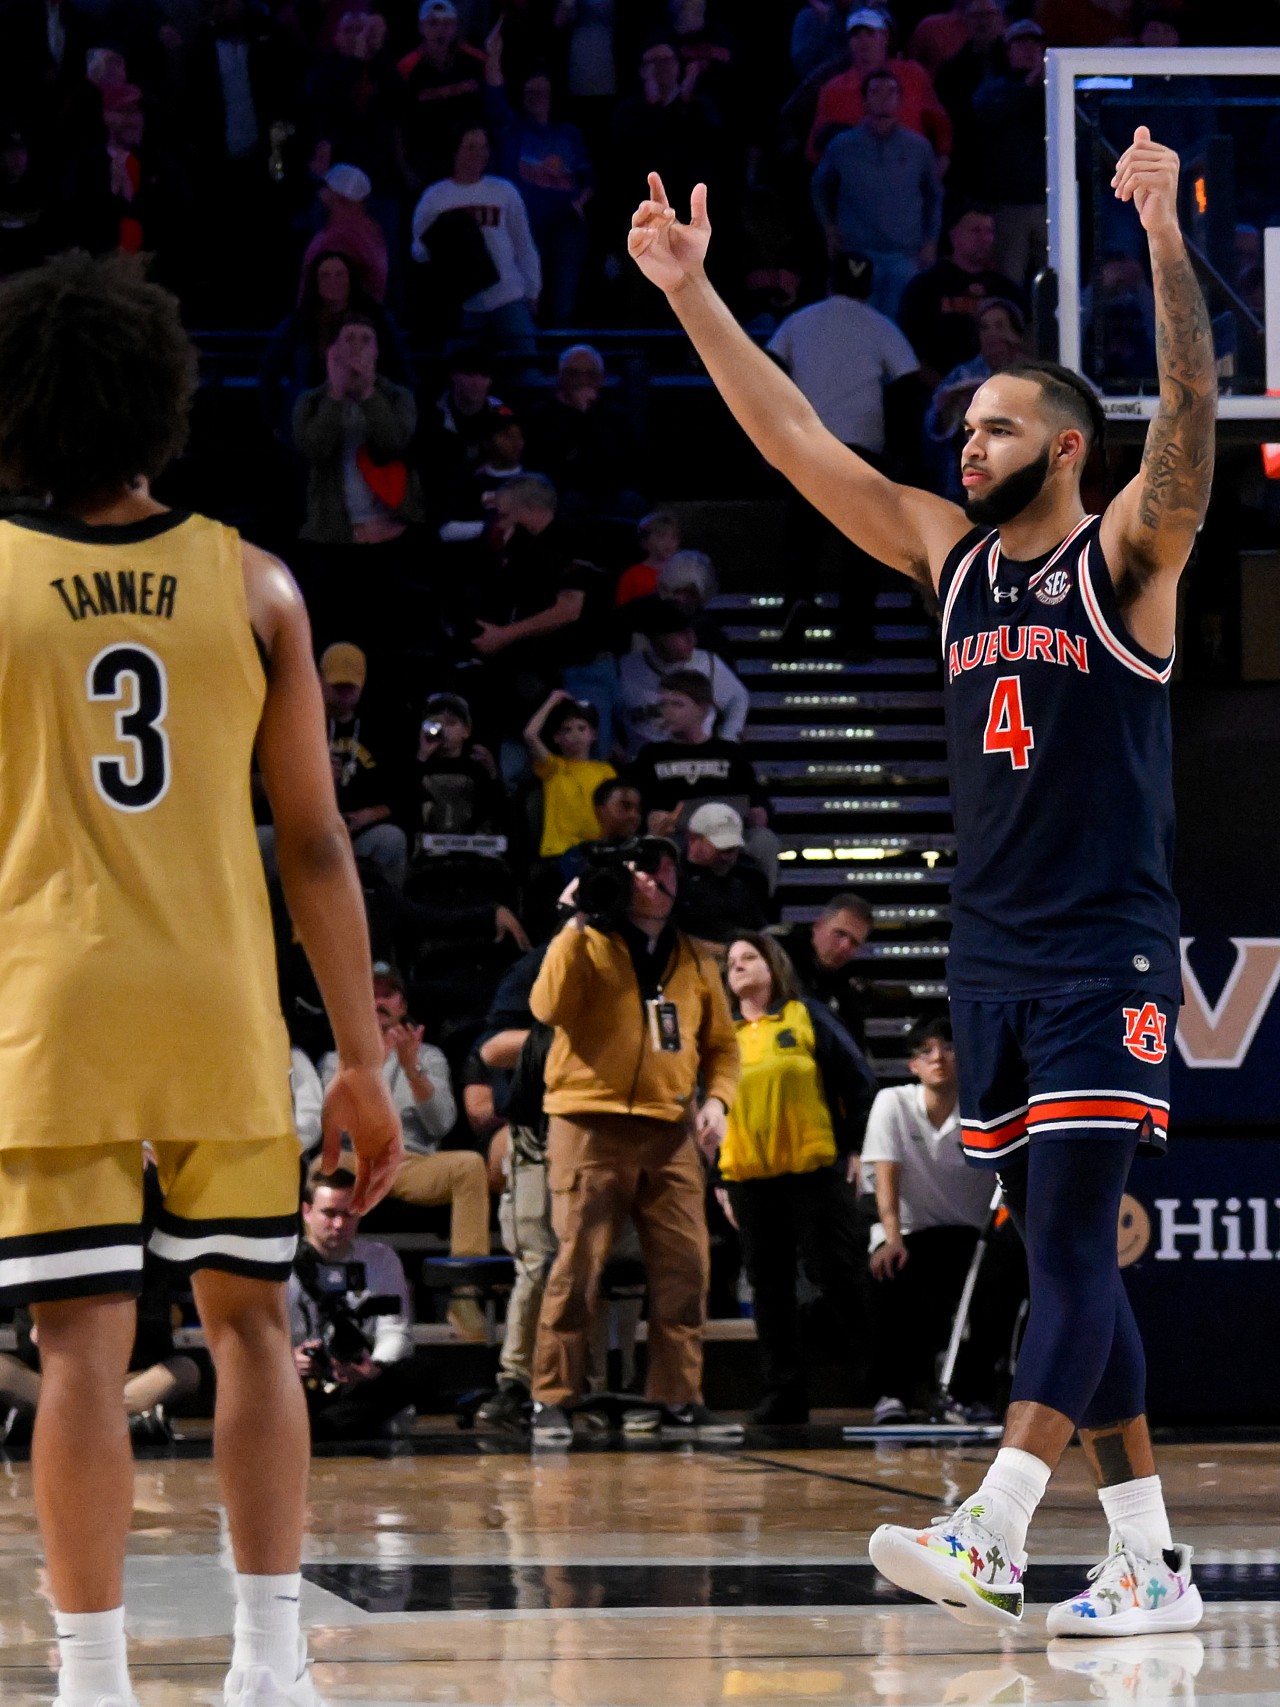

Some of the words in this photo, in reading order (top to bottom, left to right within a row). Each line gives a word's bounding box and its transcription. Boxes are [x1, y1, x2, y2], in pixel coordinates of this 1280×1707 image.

[50, 570, 178, 622] TANNER
[1044, 571, 1068, 596] SEC
[948, 625, 1090, 684] AUBURN
[86, 641, 172, 814] 3
[983, 675, 1035, 771] 4
